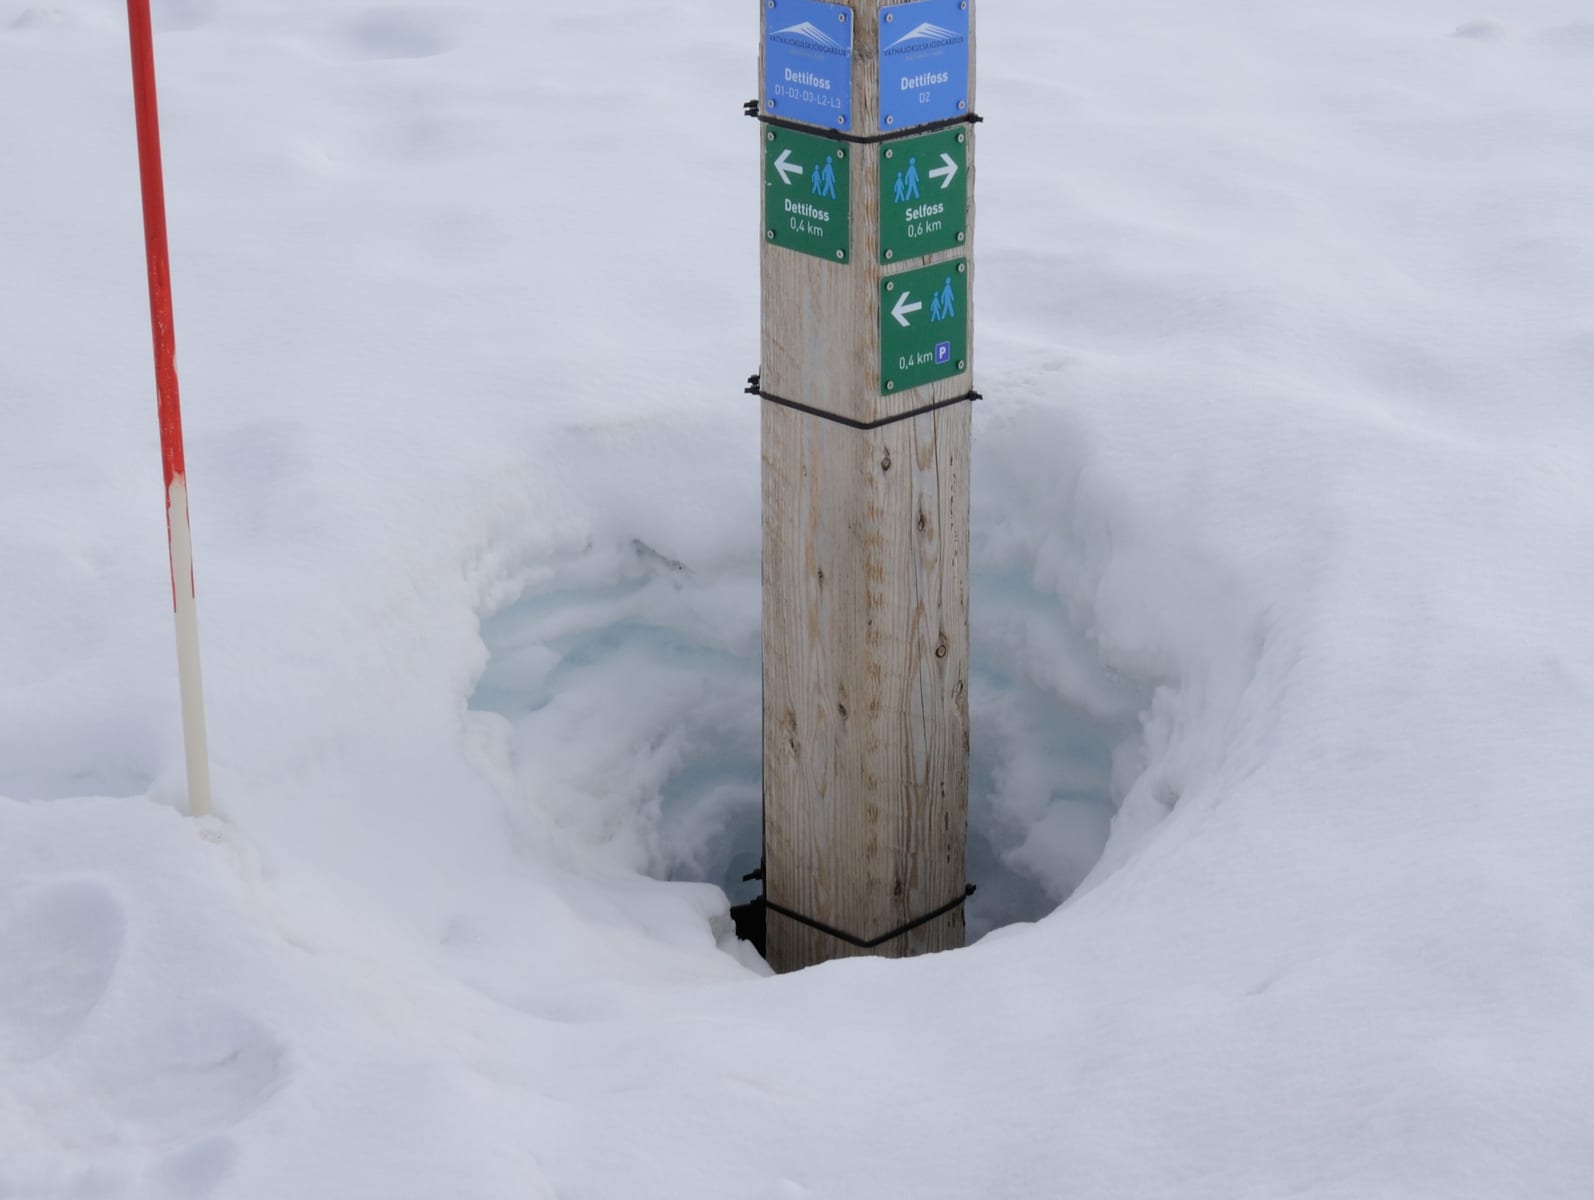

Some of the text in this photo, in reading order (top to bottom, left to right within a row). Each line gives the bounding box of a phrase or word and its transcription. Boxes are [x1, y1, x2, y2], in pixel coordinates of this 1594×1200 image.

[784, 67, 832, 91] Dettifoss
[901, 71, 949, 91] Dettifoss
[919, 91, 931, 104] D2
[784, 198, 830, 222] Dettifoss
[905, 203, 944, 221] Selfoss
[790, 216, 823, 237] 0,4 km
[907, 220, 942, 238] 0,6 km
[899, 354, 914, 370] 0,4
[917, 352, 933, 365] km
